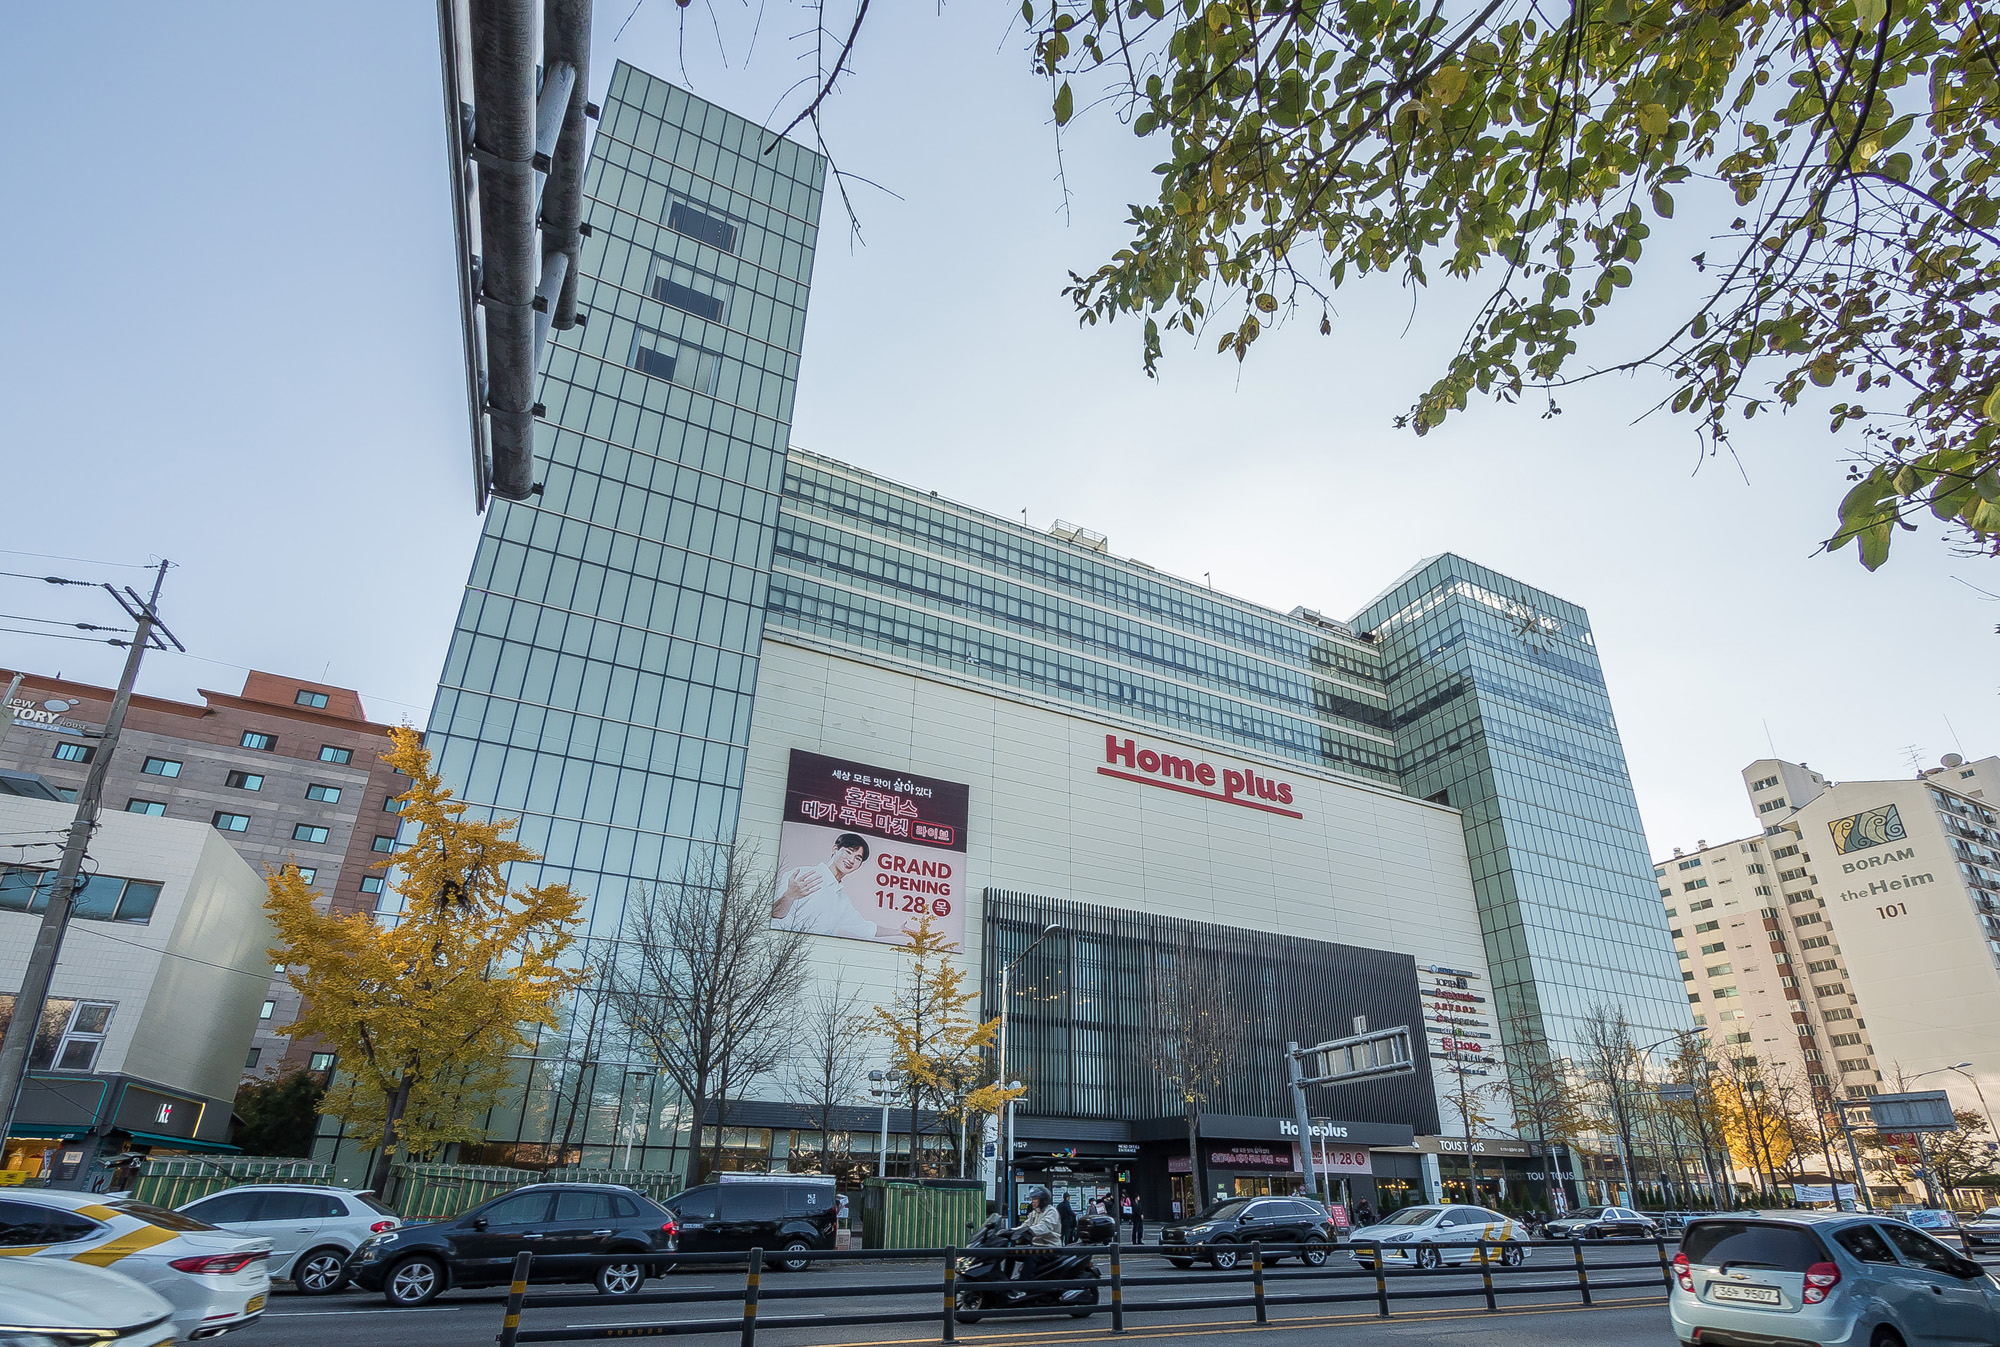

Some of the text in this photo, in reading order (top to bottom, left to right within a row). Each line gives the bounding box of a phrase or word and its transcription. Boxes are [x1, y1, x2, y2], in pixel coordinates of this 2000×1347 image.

[7, 704, 60, 724] TORY
[1106, 734, 1293, 804] Home plus
[832, 769, 933, 798] 세상 모든 맛이 살아있다
[844, 787, 918, 817] 홈플러스
[801, 800, 950, 842] 메가 푸드 마켓 라이브
[877, 853, 952, 879] GRAND
[1842, 847, 1915, 874] BORAM
[876, 873, 951, 896] OPENING
[1840, 872, 1935, 902] the Heim
[934, 900, 950, 916] 목
[1876, 902, 1908, 920] 101
[1280, 1120, 1348, 1138] Hoeplus
[1439, 1140, 1461, 1152] TOUS
[1326, 1152, 1354, 1165] 11.28.
[1526, 1172, 1546, 1181] TOU
[1744, 1288, 1772, 1300] 9507
